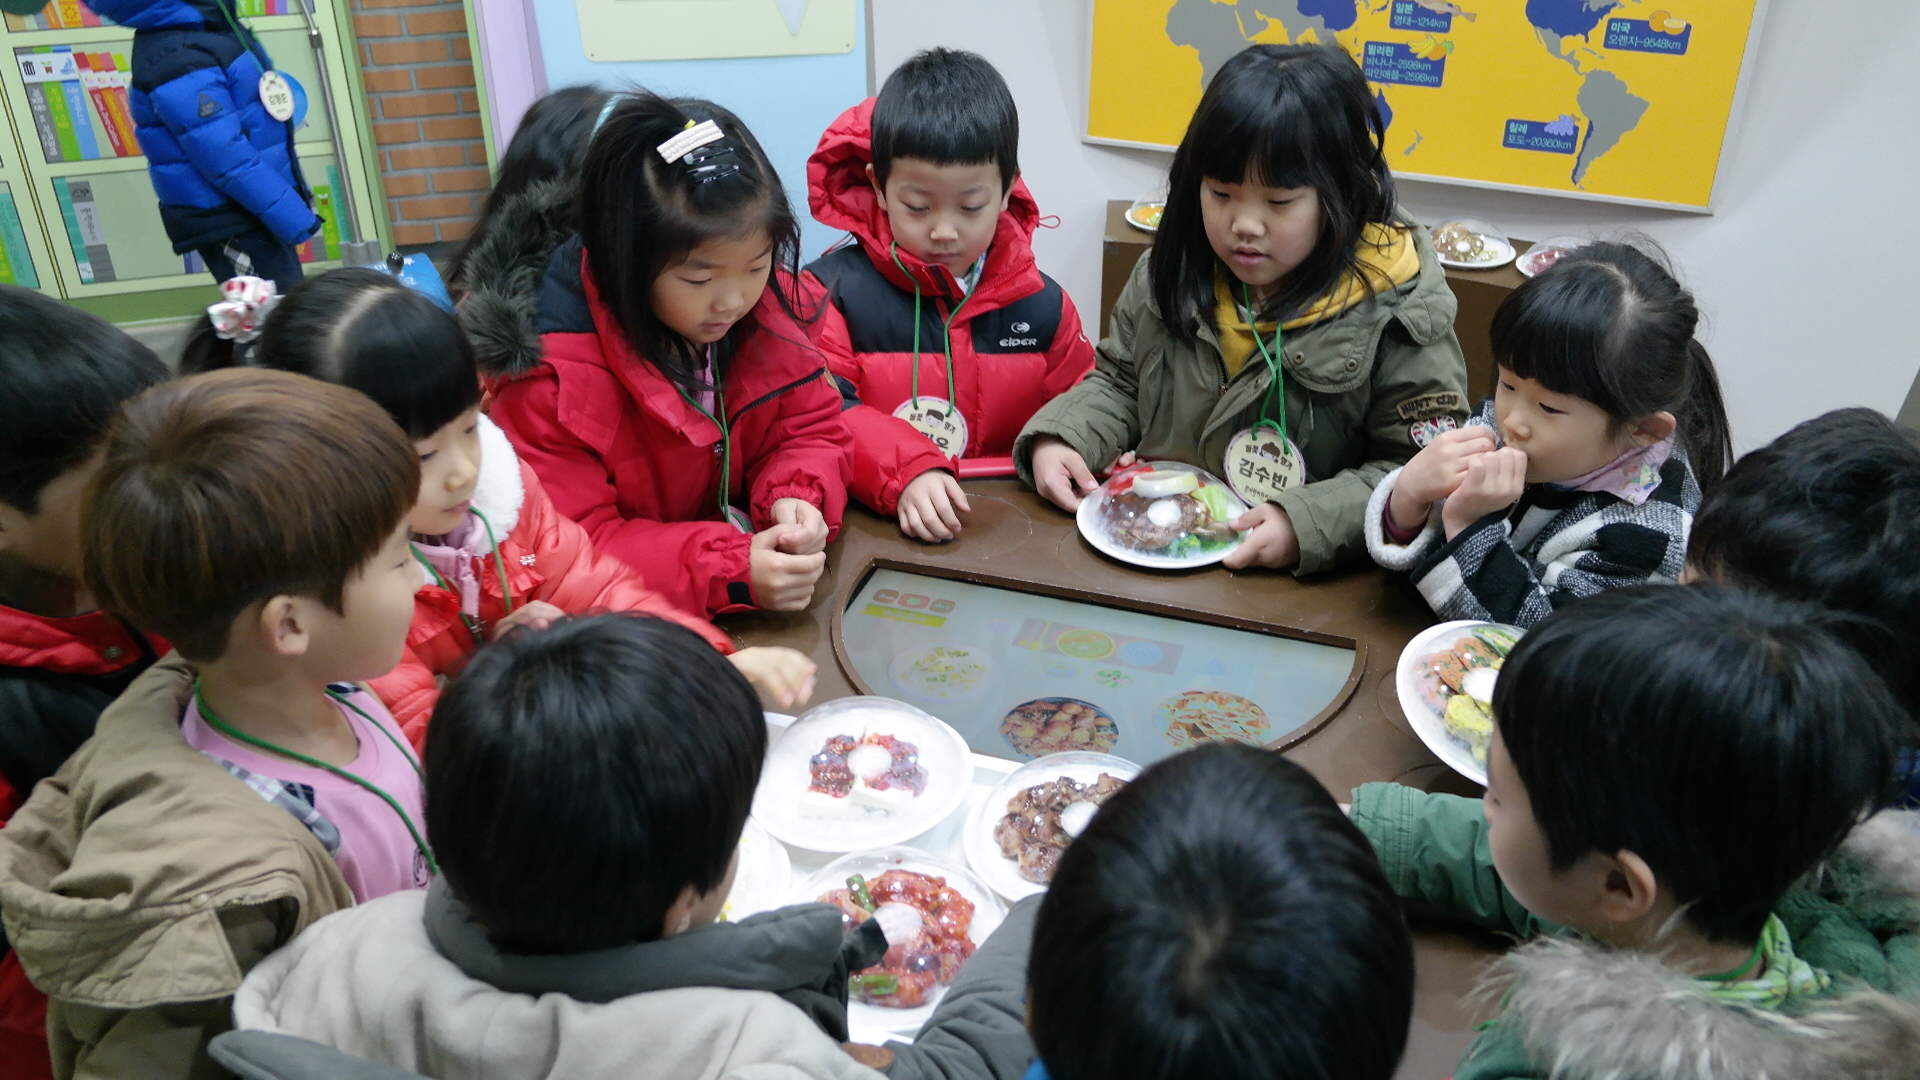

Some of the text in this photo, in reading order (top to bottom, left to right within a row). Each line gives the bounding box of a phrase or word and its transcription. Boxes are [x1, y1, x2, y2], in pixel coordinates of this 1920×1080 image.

[1395, 2, 1413, 15] 일본
[1393, 15, 1448, 28] 명태-1214km
[1610, 21, 1631, 34] 미국
[1608, 34, 1681, 50] 오렌지-9548km
[1367, 44, 1394, 57] 필리핀
[1509, 121, 1528, 134] 칠레
[1506, 133, 1572, 150] 포도-20360km
[1238, 457, 1288, 493] 김수빈
